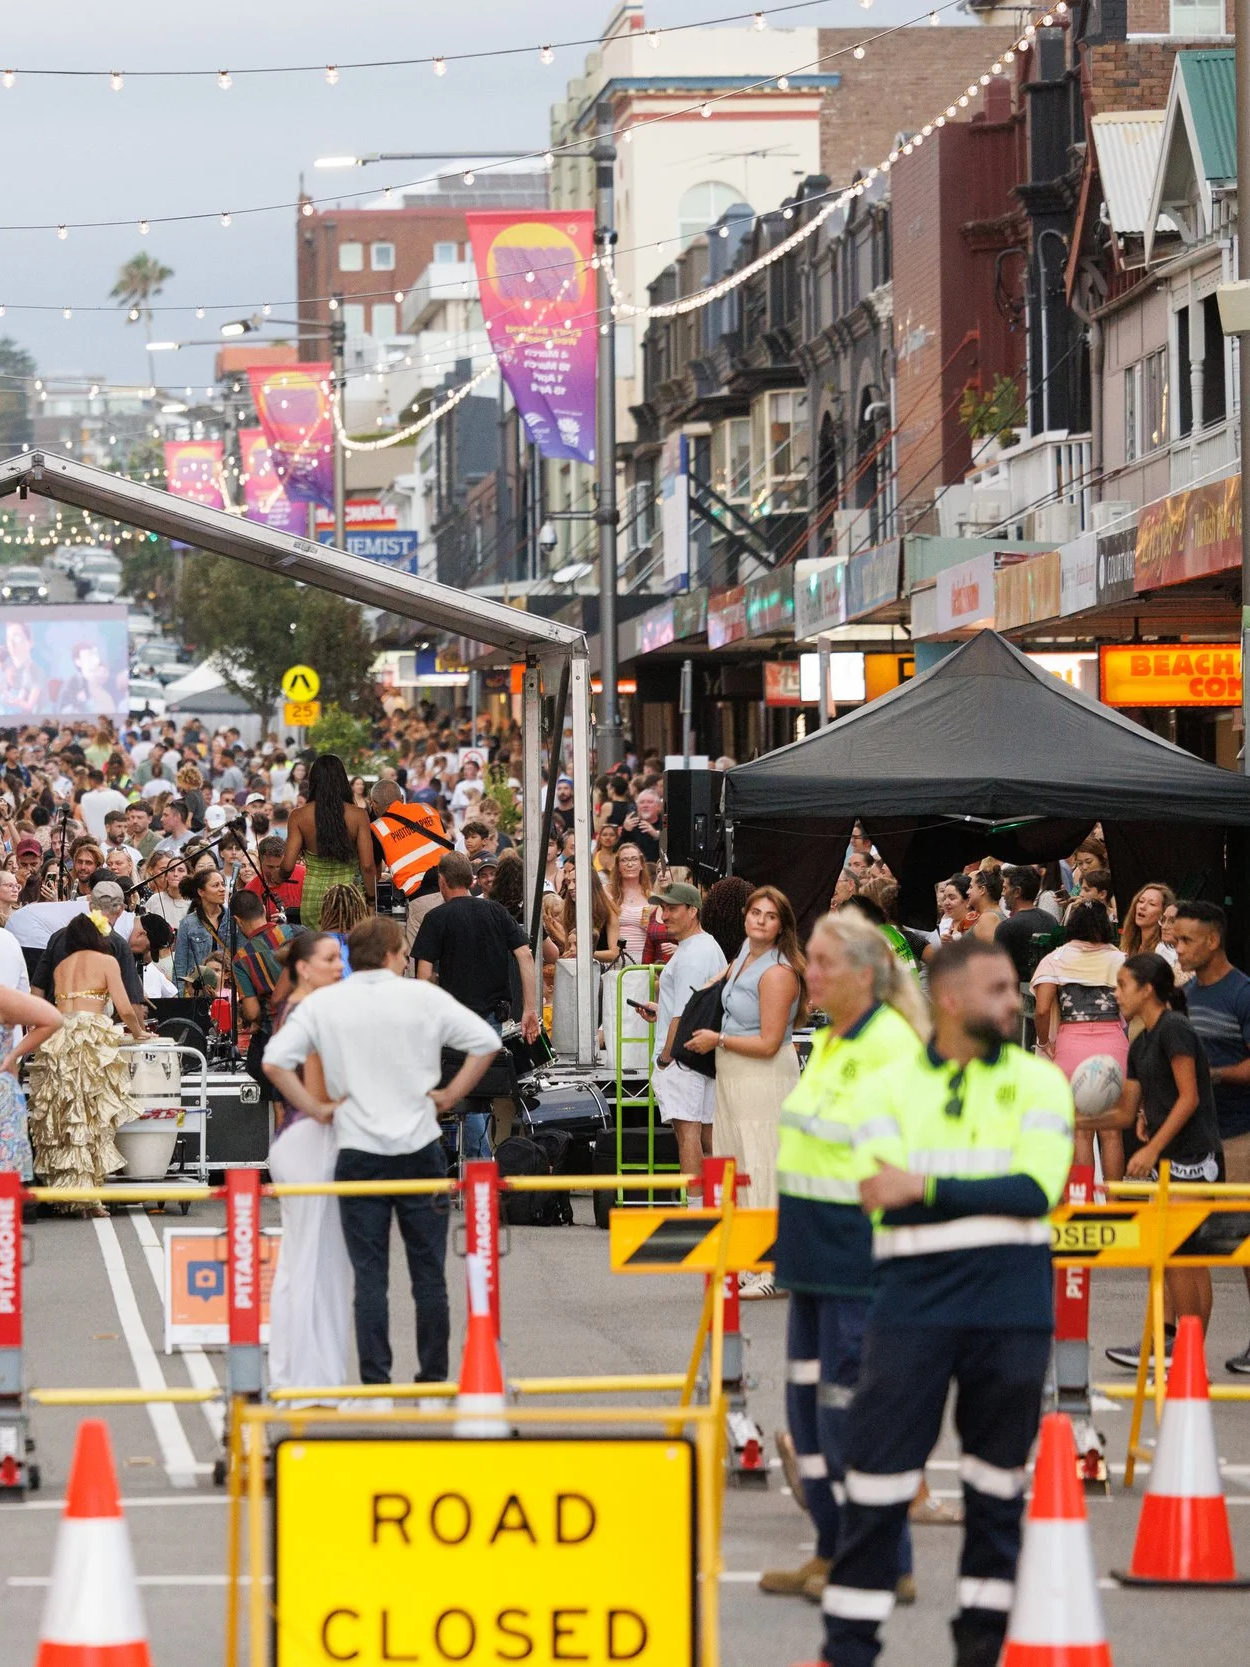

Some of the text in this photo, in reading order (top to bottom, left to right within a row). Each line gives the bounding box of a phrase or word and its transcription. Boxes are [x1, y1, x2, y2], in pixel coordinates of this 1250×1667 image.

[1130, 654, 1234, 677] BEACH
[293, 705, 313, 718] 25
[233, 1192, 254, 1309] PITAGONE
[370, 1492, 598, 1545] ROAD
[320, 1608, 649, 1661] CLOSED
